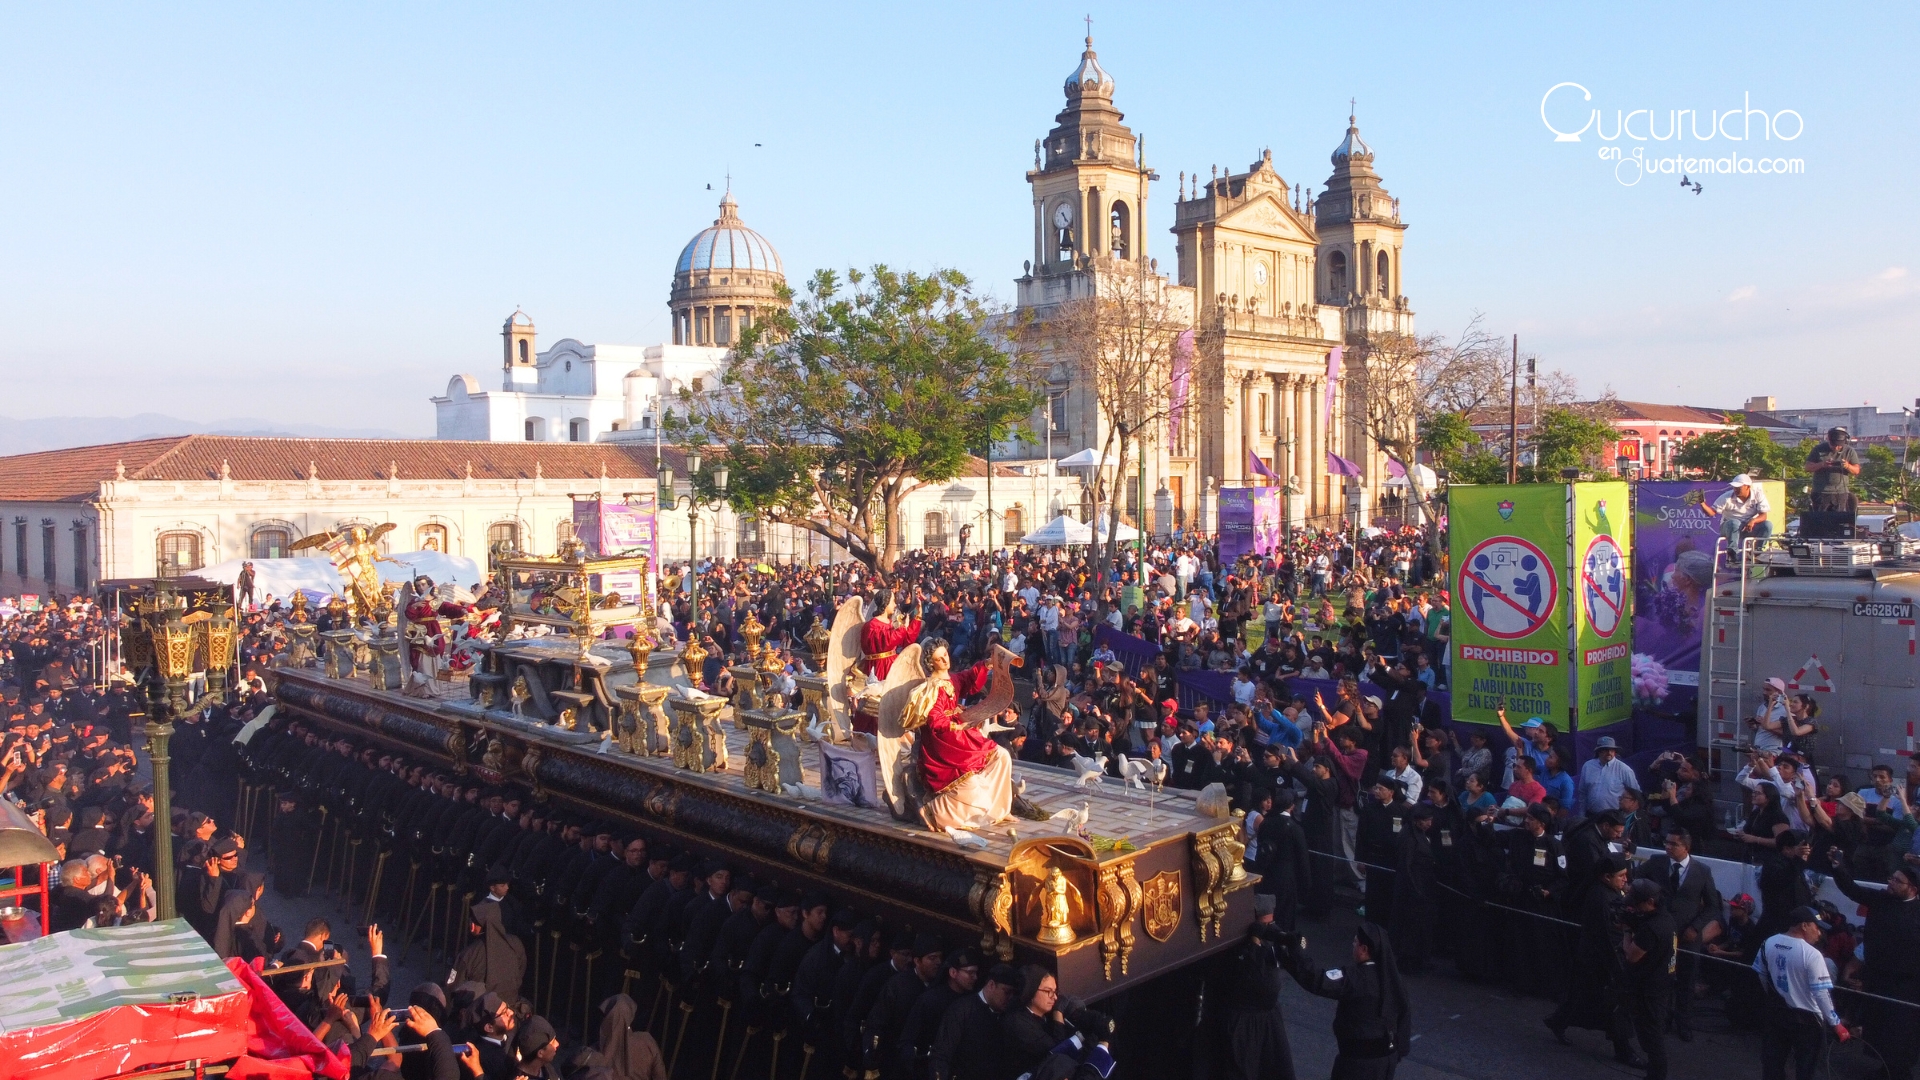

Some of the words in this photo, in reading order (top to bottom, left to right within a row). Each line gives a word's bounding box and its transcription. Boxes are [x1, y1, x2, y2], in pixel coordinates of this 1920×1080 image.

[1657, 505, 1717, 521] SEMAN
[1669, 519, 1720, 535] MAYOR
[1497, 554, 1504, 562] Q
[1854, 603, 1910, 617] C-662BCW
[1463, 647, 1554, 665] PROHIBIDO
[1487, 662, 1527, 679] VENTAS
[1473, 678, 1544, 698] AMBULANTES
[1468, 694, 1480, 708] EN
[1484, 695, 1506, 710] ES
[1510, 697, 1551, 715] SECTOR
